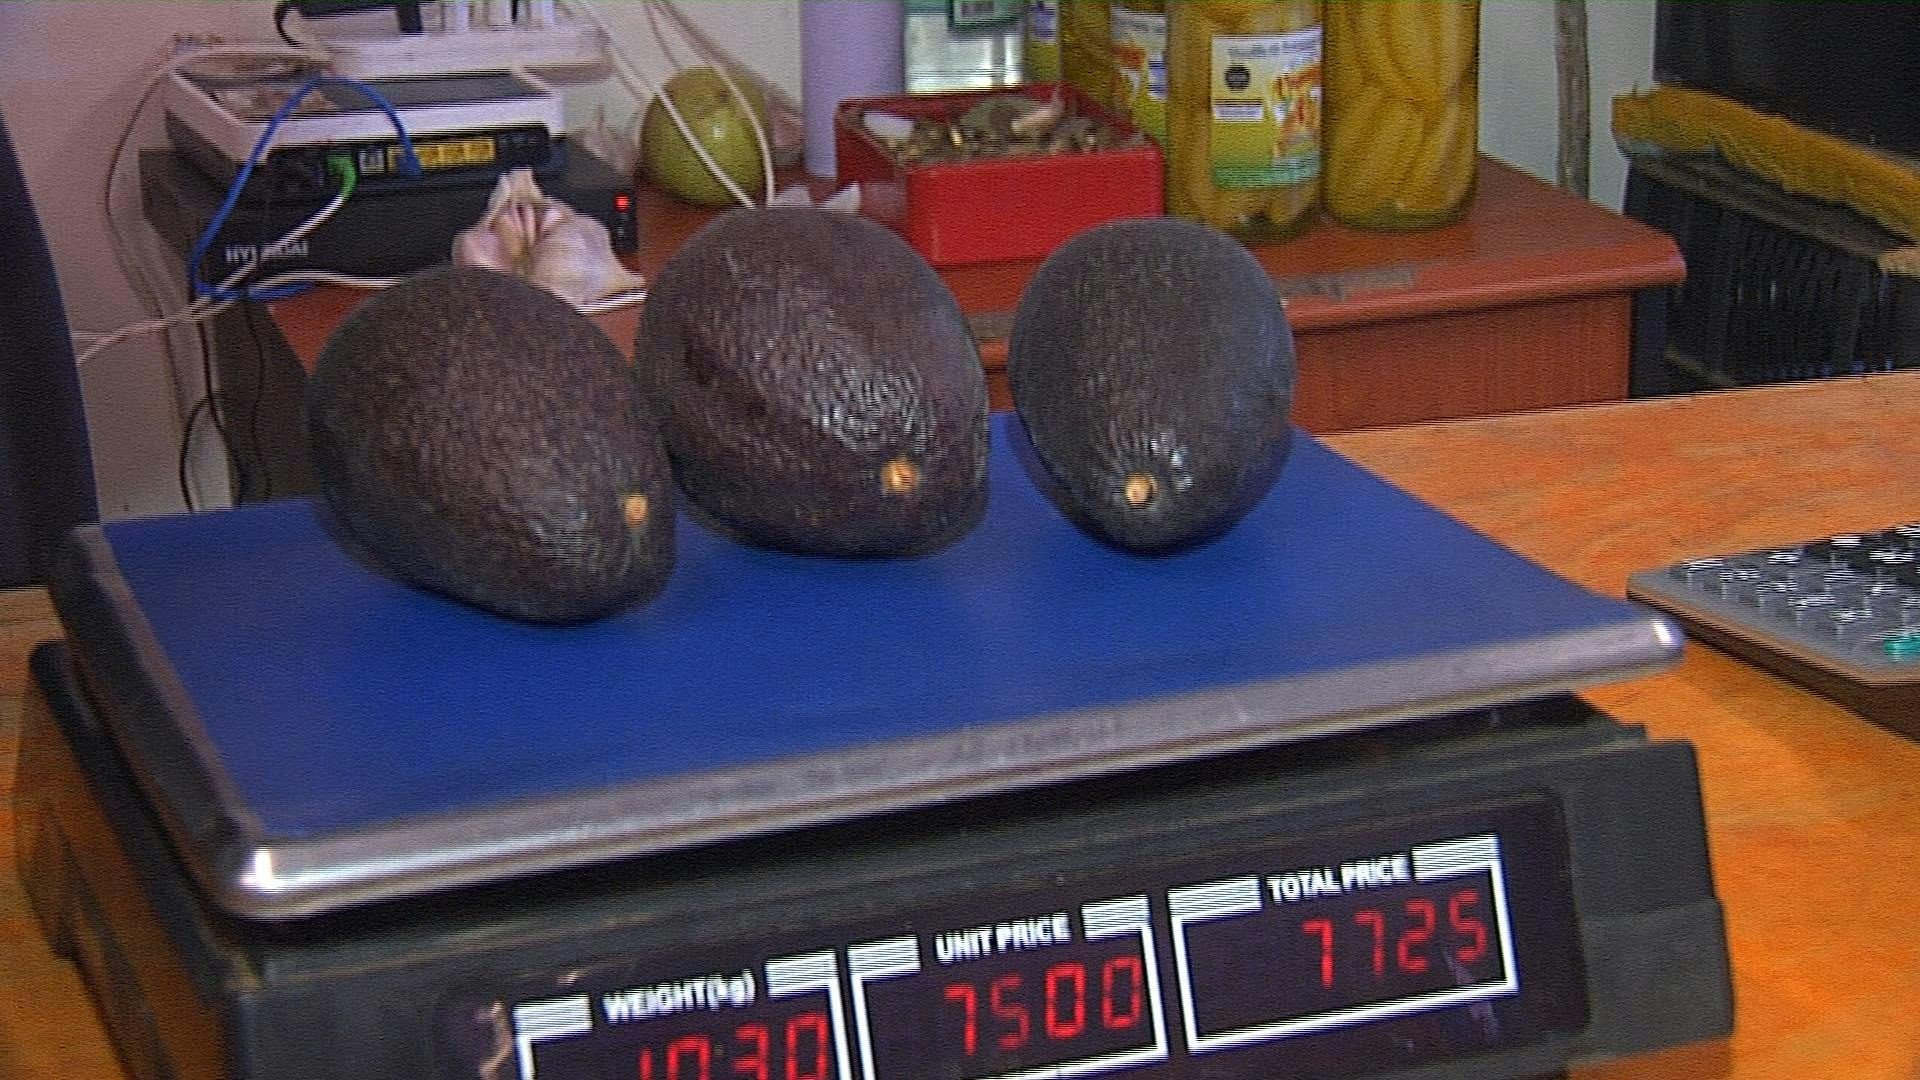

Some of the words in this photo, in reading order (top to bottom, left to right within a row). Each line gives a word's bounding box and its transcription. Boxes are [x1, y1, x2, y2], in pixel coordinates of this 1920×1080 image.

[225, 241, 309, 263] HYDAI
[1265, 867, 1341, 904] TOTAL
[1340, 854, 1413, 890] PRICE
[934, 926, 993, 964] UNIT
[995, 912, 1071, 953] PRICE
[1302, 888, 1488, 990] 7725
[601, 969, 756, 1024] WEIGHT(kg)
[943, 955, 1143, 1056] 7500
